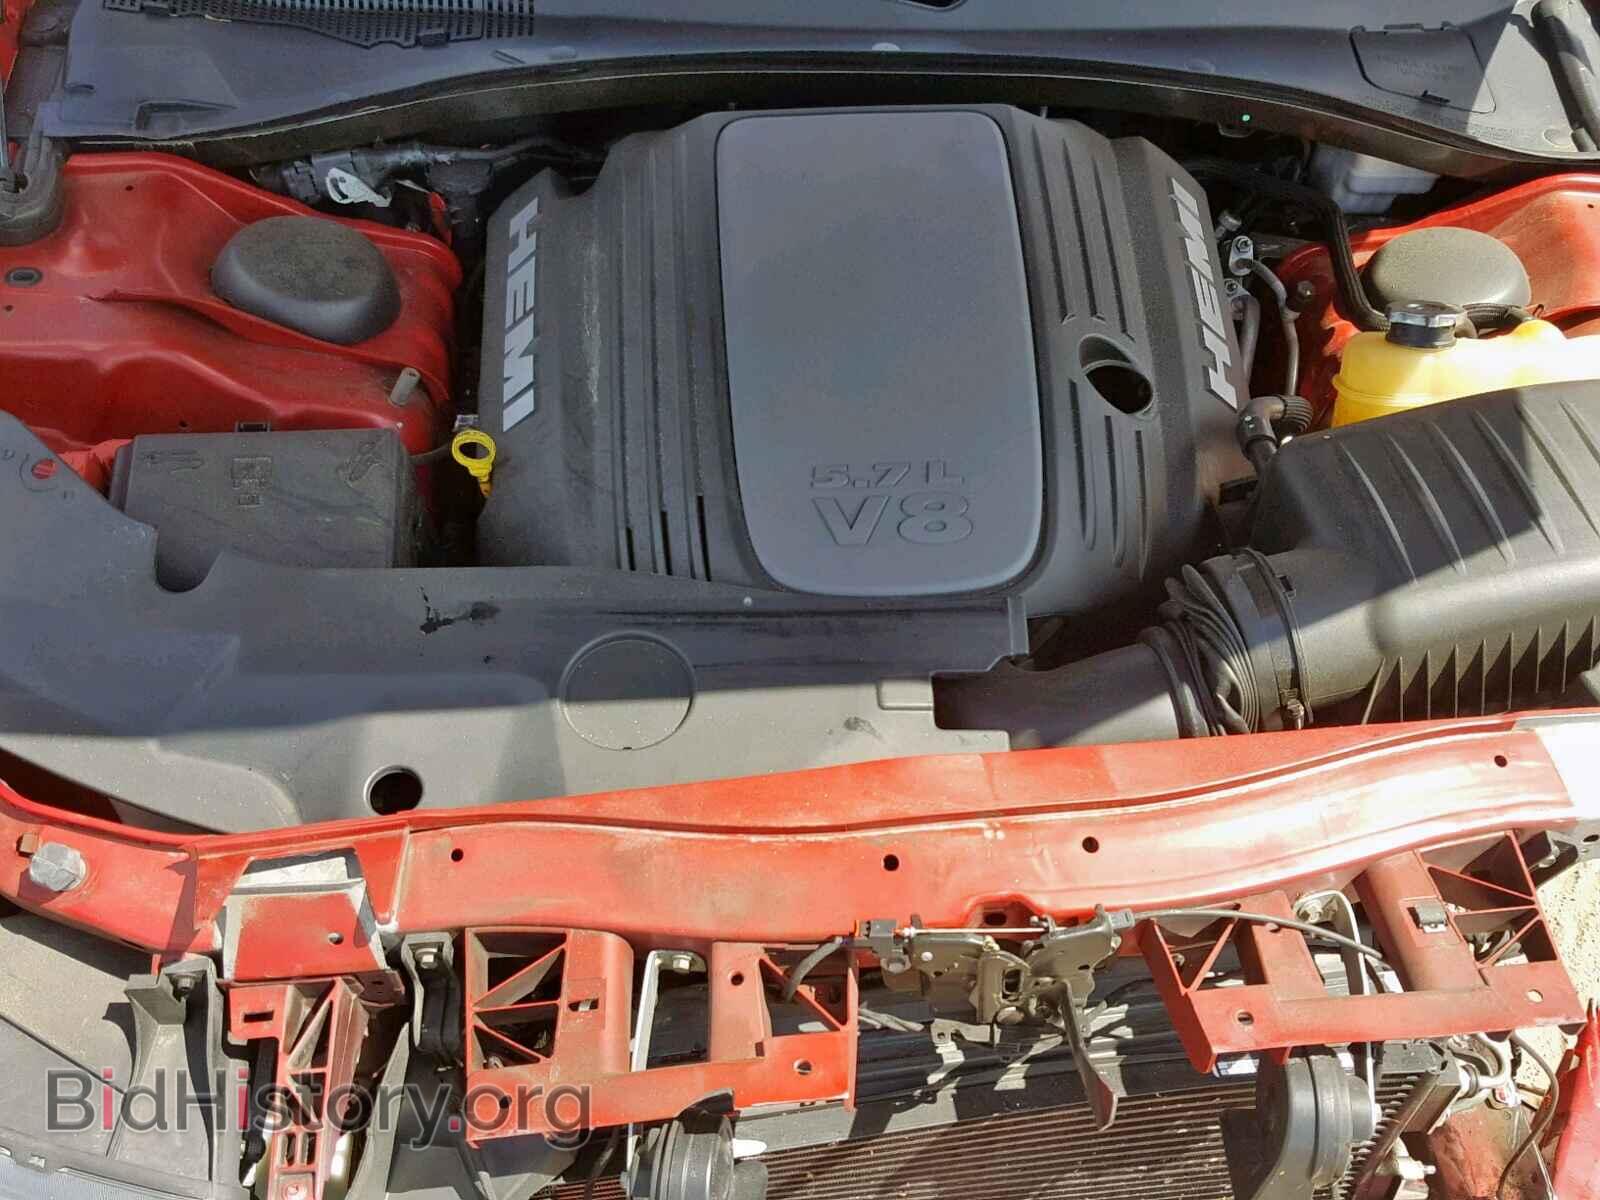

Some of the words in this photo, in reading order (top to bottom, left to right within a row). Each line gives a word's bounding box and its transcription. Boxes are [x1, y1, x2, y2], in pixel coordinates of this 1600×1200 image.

[503, 196, 538, 432] HEMI
[1171, 177, 1238, 410] HEMI
[811, 491, 974, 545] V8
